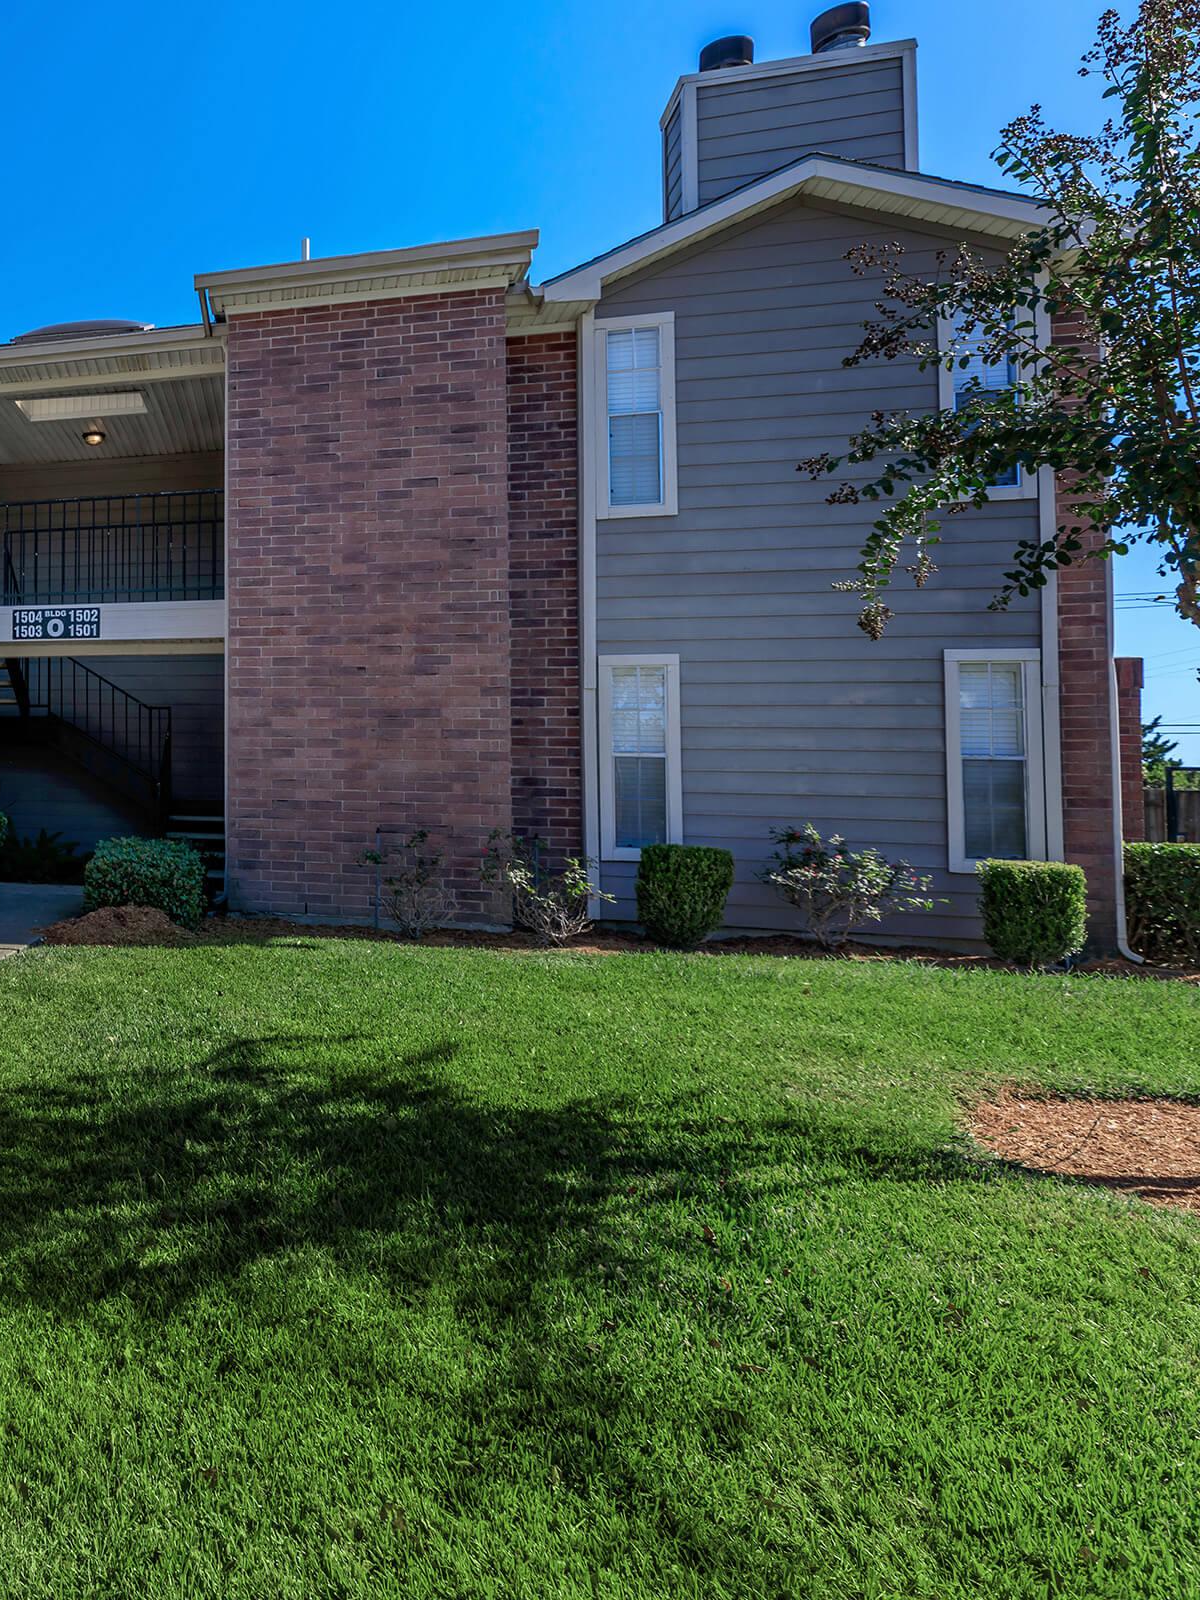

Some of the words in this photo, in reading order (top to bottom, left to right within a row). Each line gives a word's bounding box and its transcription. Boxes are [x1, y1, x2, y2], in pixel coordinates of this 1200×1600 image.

[14, 611, 43, 623] 1504
[68, 609, 98, 622] 1502
[14, 625, 43, 638] 1503
[47, 618, 64, 637] O
[68, 624, 97, 636] 1501
